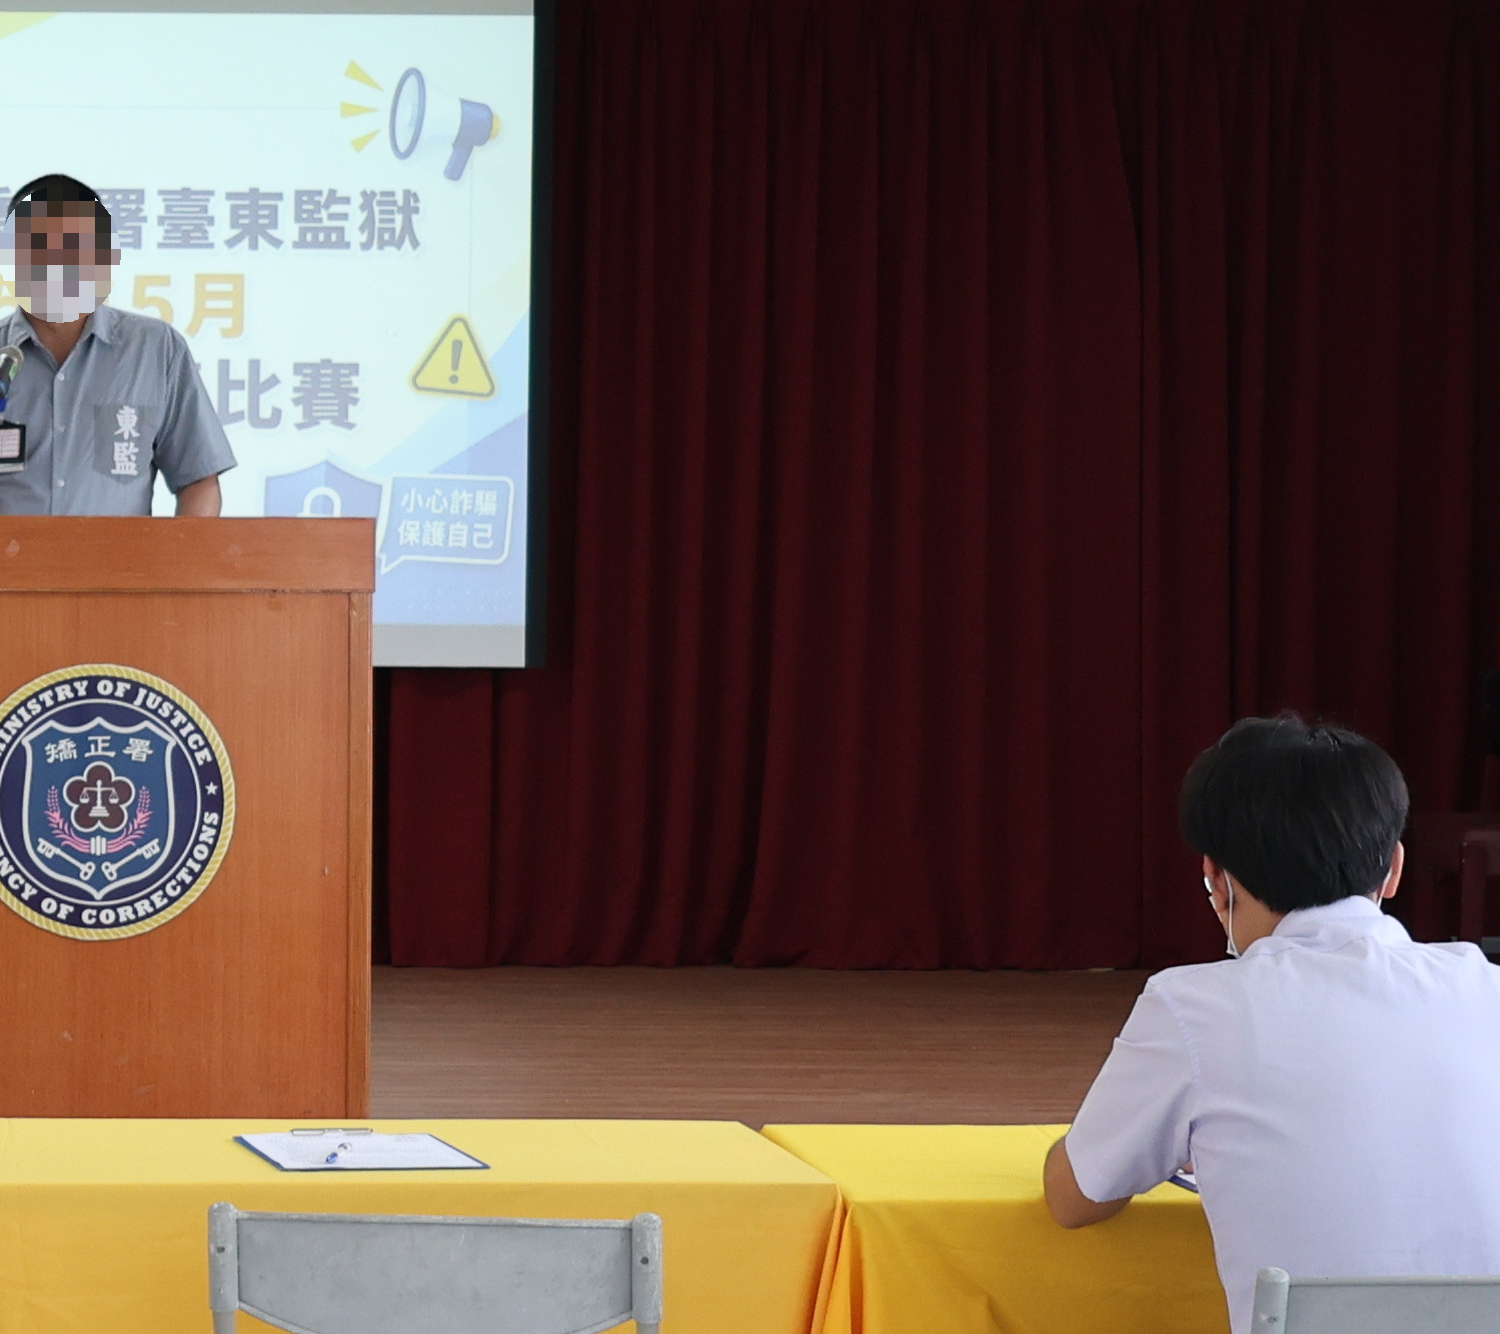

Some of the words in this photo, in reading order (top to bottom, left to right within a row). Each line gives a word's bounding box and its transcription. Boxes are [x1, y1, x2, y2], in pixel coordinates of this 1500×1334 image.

[111, 405, 141, 476] 東監
[401, 488, 497, 516] 小心詐騙
[398, 520, 494, 549] 保護自己
[97, 679, 131, 698] OF
[134, 688, 213, 766] JUSTICE
[44, 735, 153, 763] 矯正署
[41, 898, 74, 921] OF
[81, 812, 220, 925] CORRECTIONS
